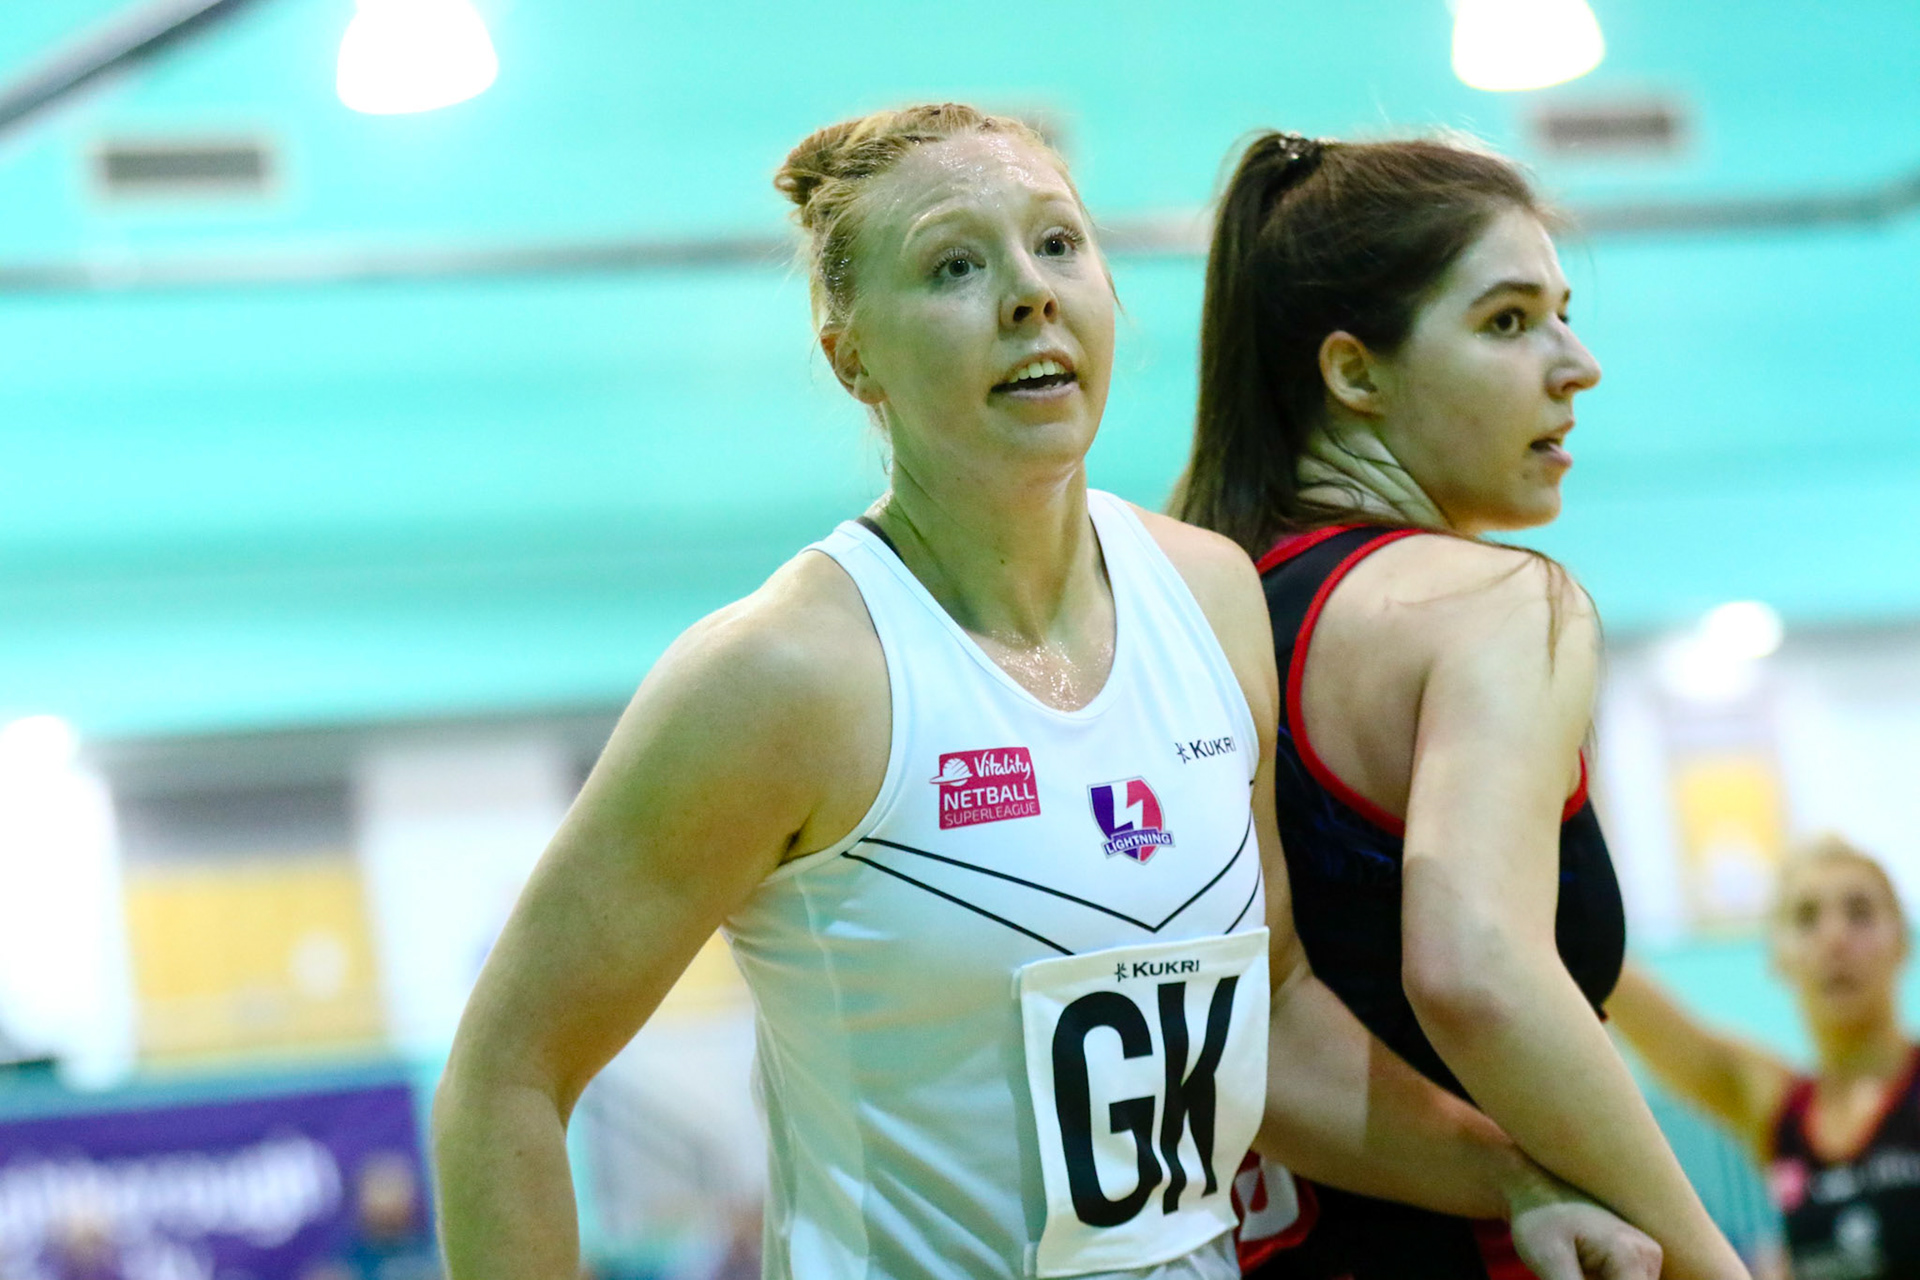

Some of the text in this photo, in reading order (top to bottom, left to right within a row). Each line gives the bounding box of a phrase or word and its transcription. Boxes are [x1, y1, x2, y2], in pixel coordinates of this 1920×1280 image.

[1189, 736, 1236, 759] KUKRI
[974, 751, 1031, 780] Vitality
[944, 783, 1035, 811] NETBALL
[944, 802, 1037, 827] SUPERLEAGUE
[1106, 832, 1171, 855] LIGHTNING
[1133, 959, 1200, 978] KUKRI
[1052, 975, 1240, 1228] GK
